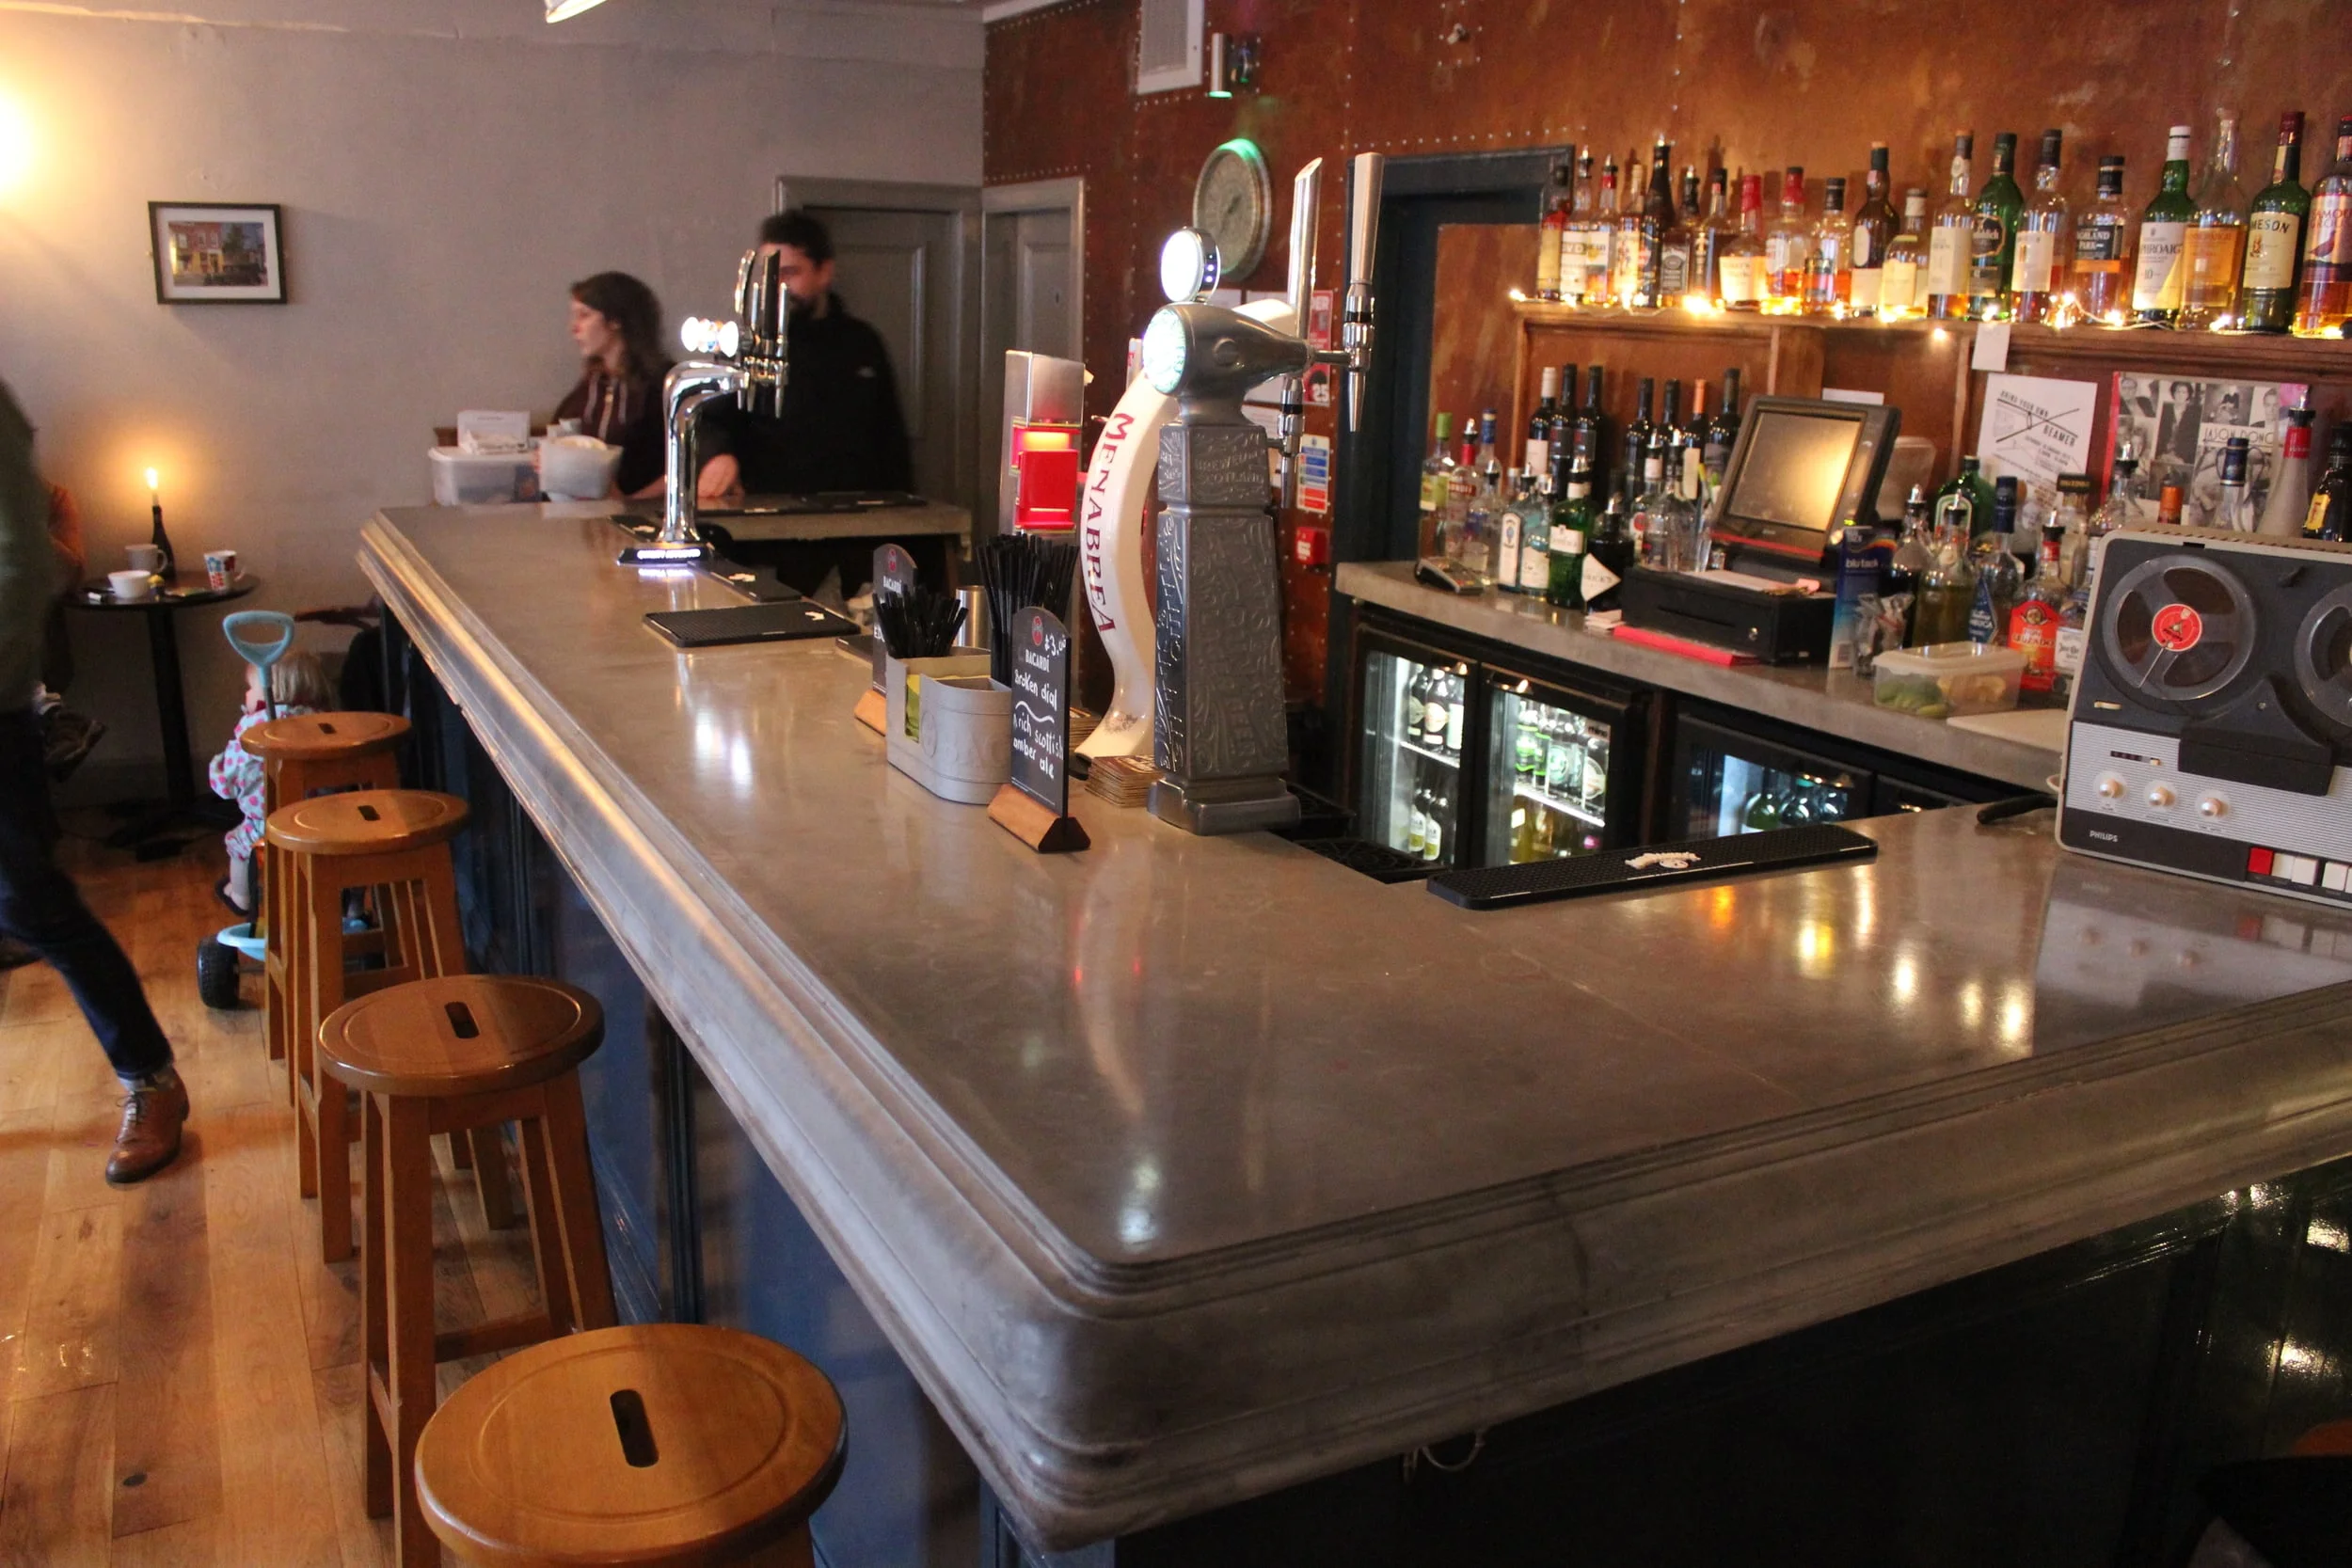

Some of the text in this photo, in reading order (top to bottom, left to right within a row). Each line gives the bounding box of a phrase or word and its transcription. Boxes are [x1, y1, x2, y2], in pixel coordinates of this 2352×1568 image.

[2043, 424, 2076, 448] BEAMER
[2204, 427, 2236, 440] JASON
[1086, 412, 1135, 633] MENABREA
[1014, 669, 1057, 712] Broken dial
[1018, 712, 1032, 737] rich
[1012, 738, 1055, 779] amber ale
[2089, 830, 2119, 843] PHILIPS
